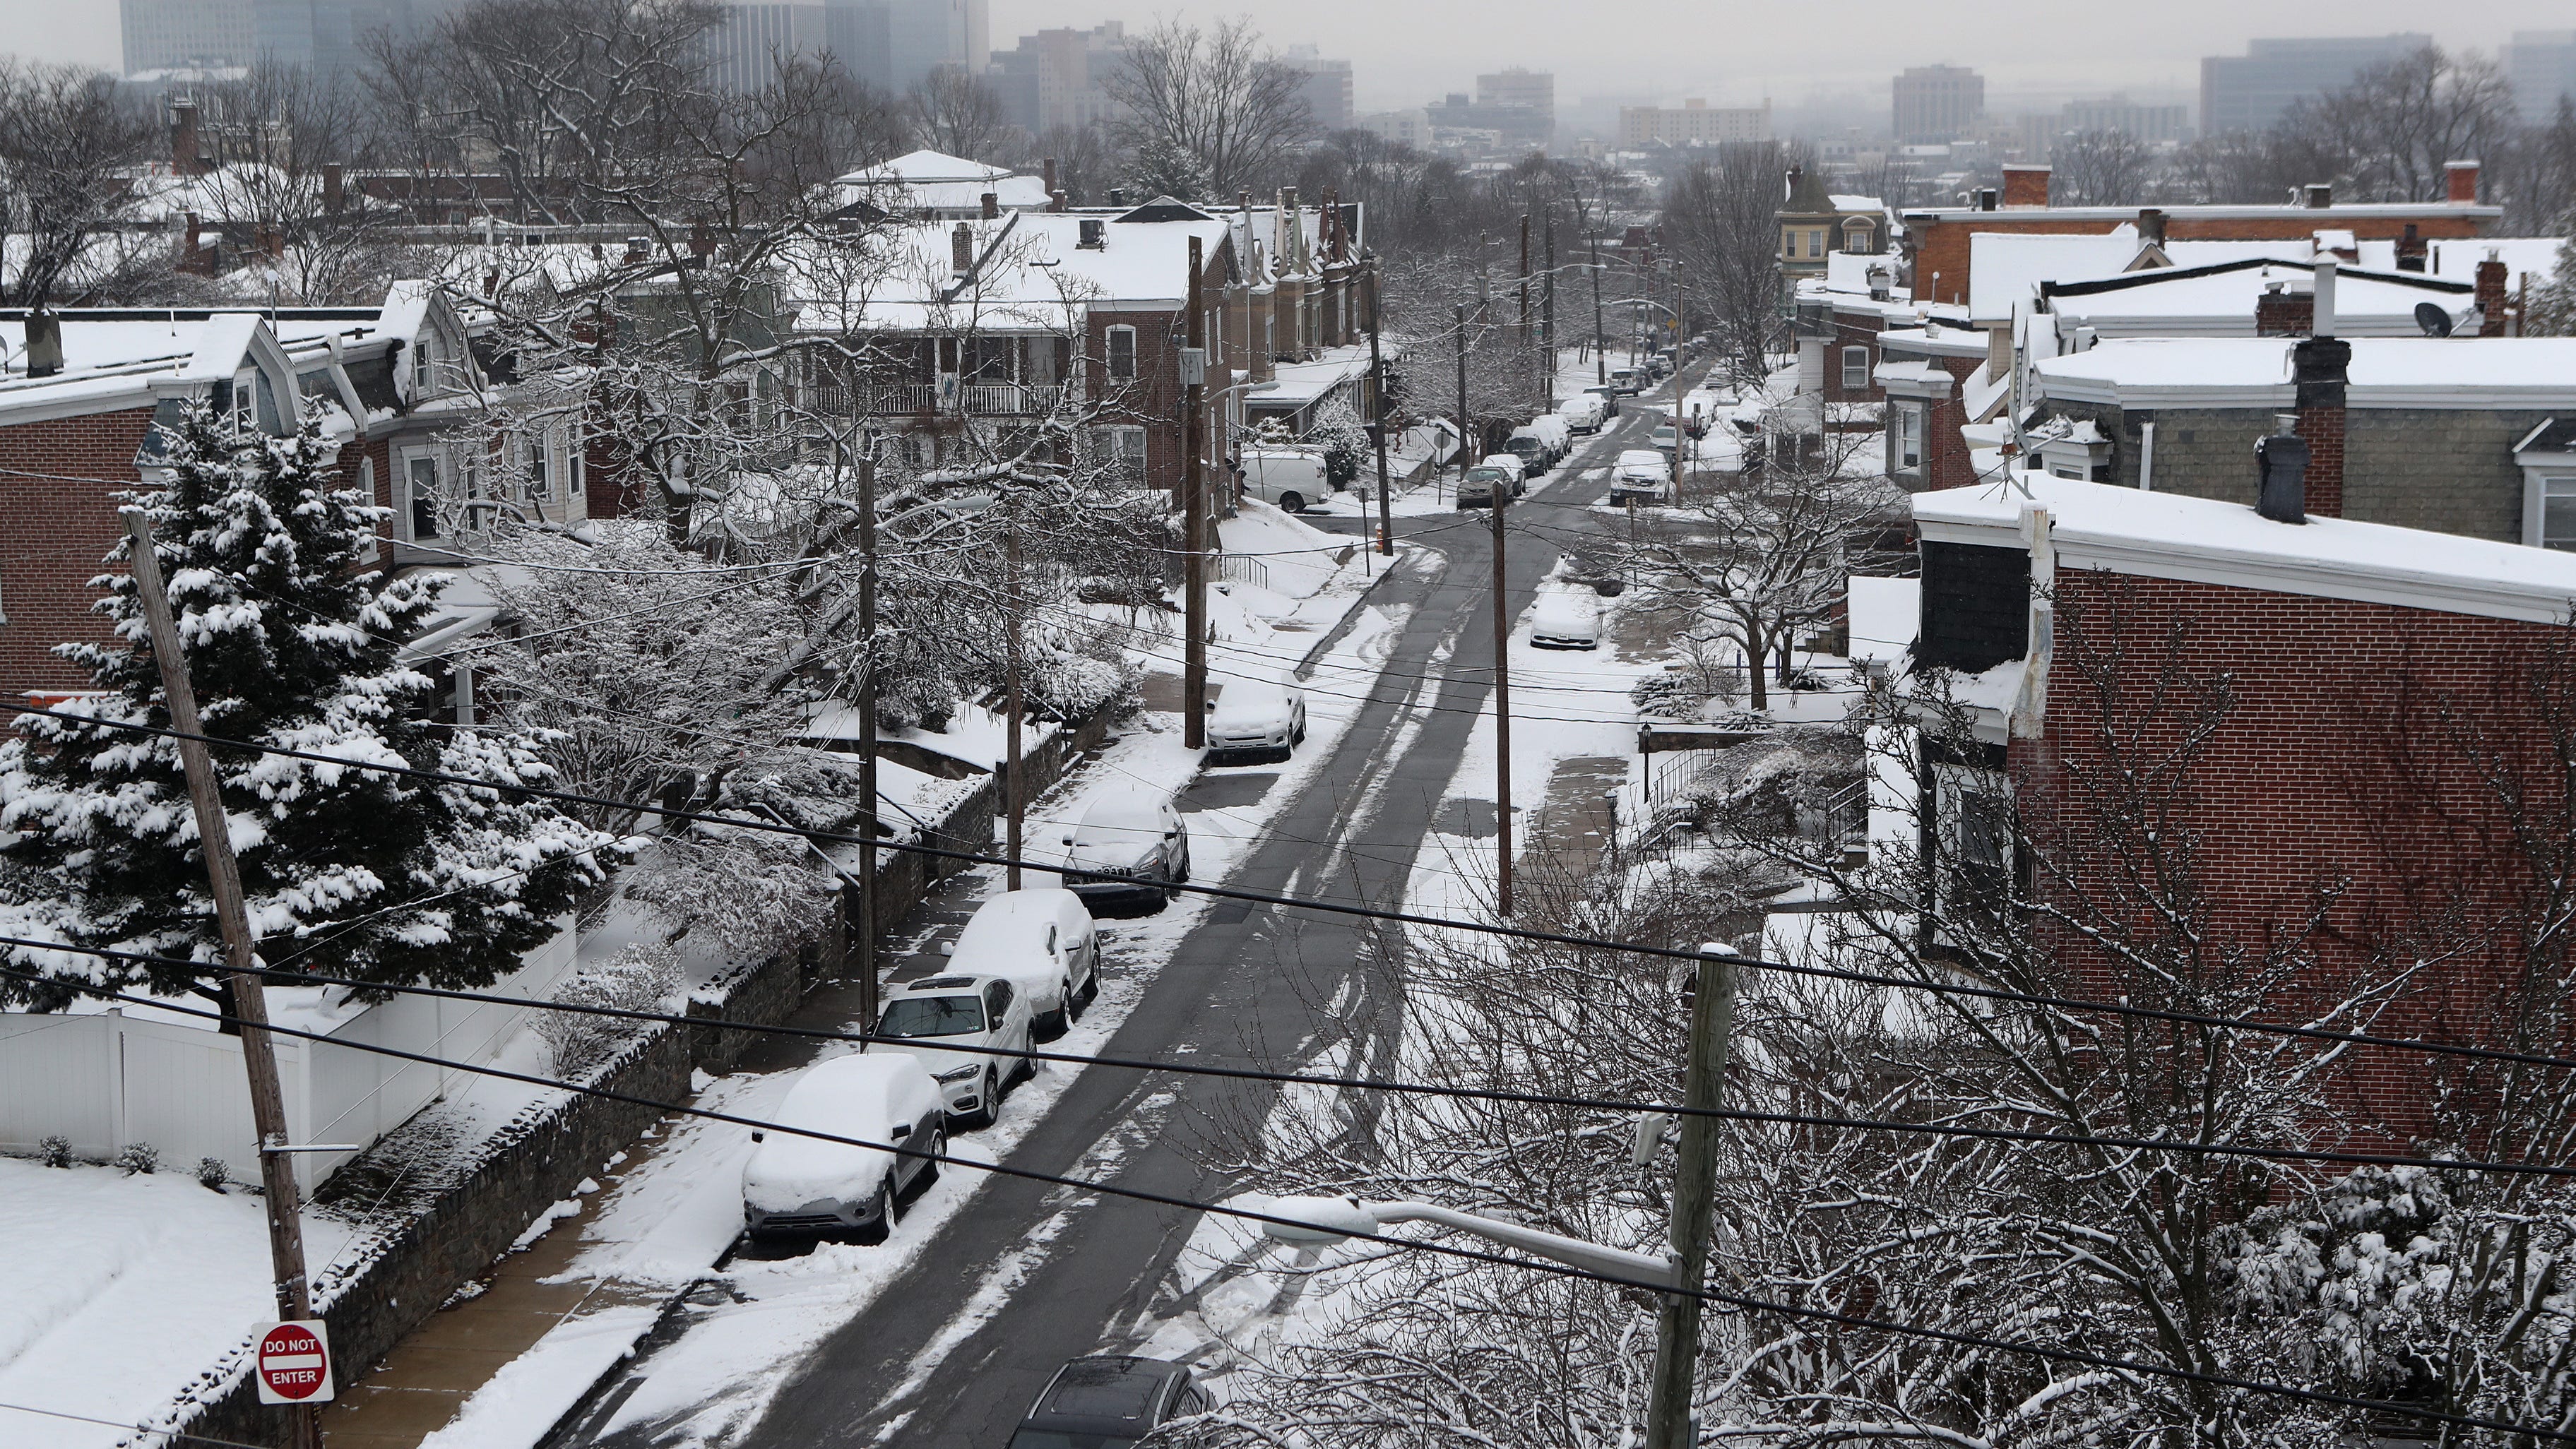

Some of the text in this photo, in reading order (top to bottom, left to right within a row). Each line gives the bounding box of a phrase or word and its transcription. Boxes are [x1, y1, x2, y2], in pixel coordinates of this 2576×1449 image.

[266, 1339, 316, 1353] DO NOT
[272, 1371, 317, 1385] ENTER
